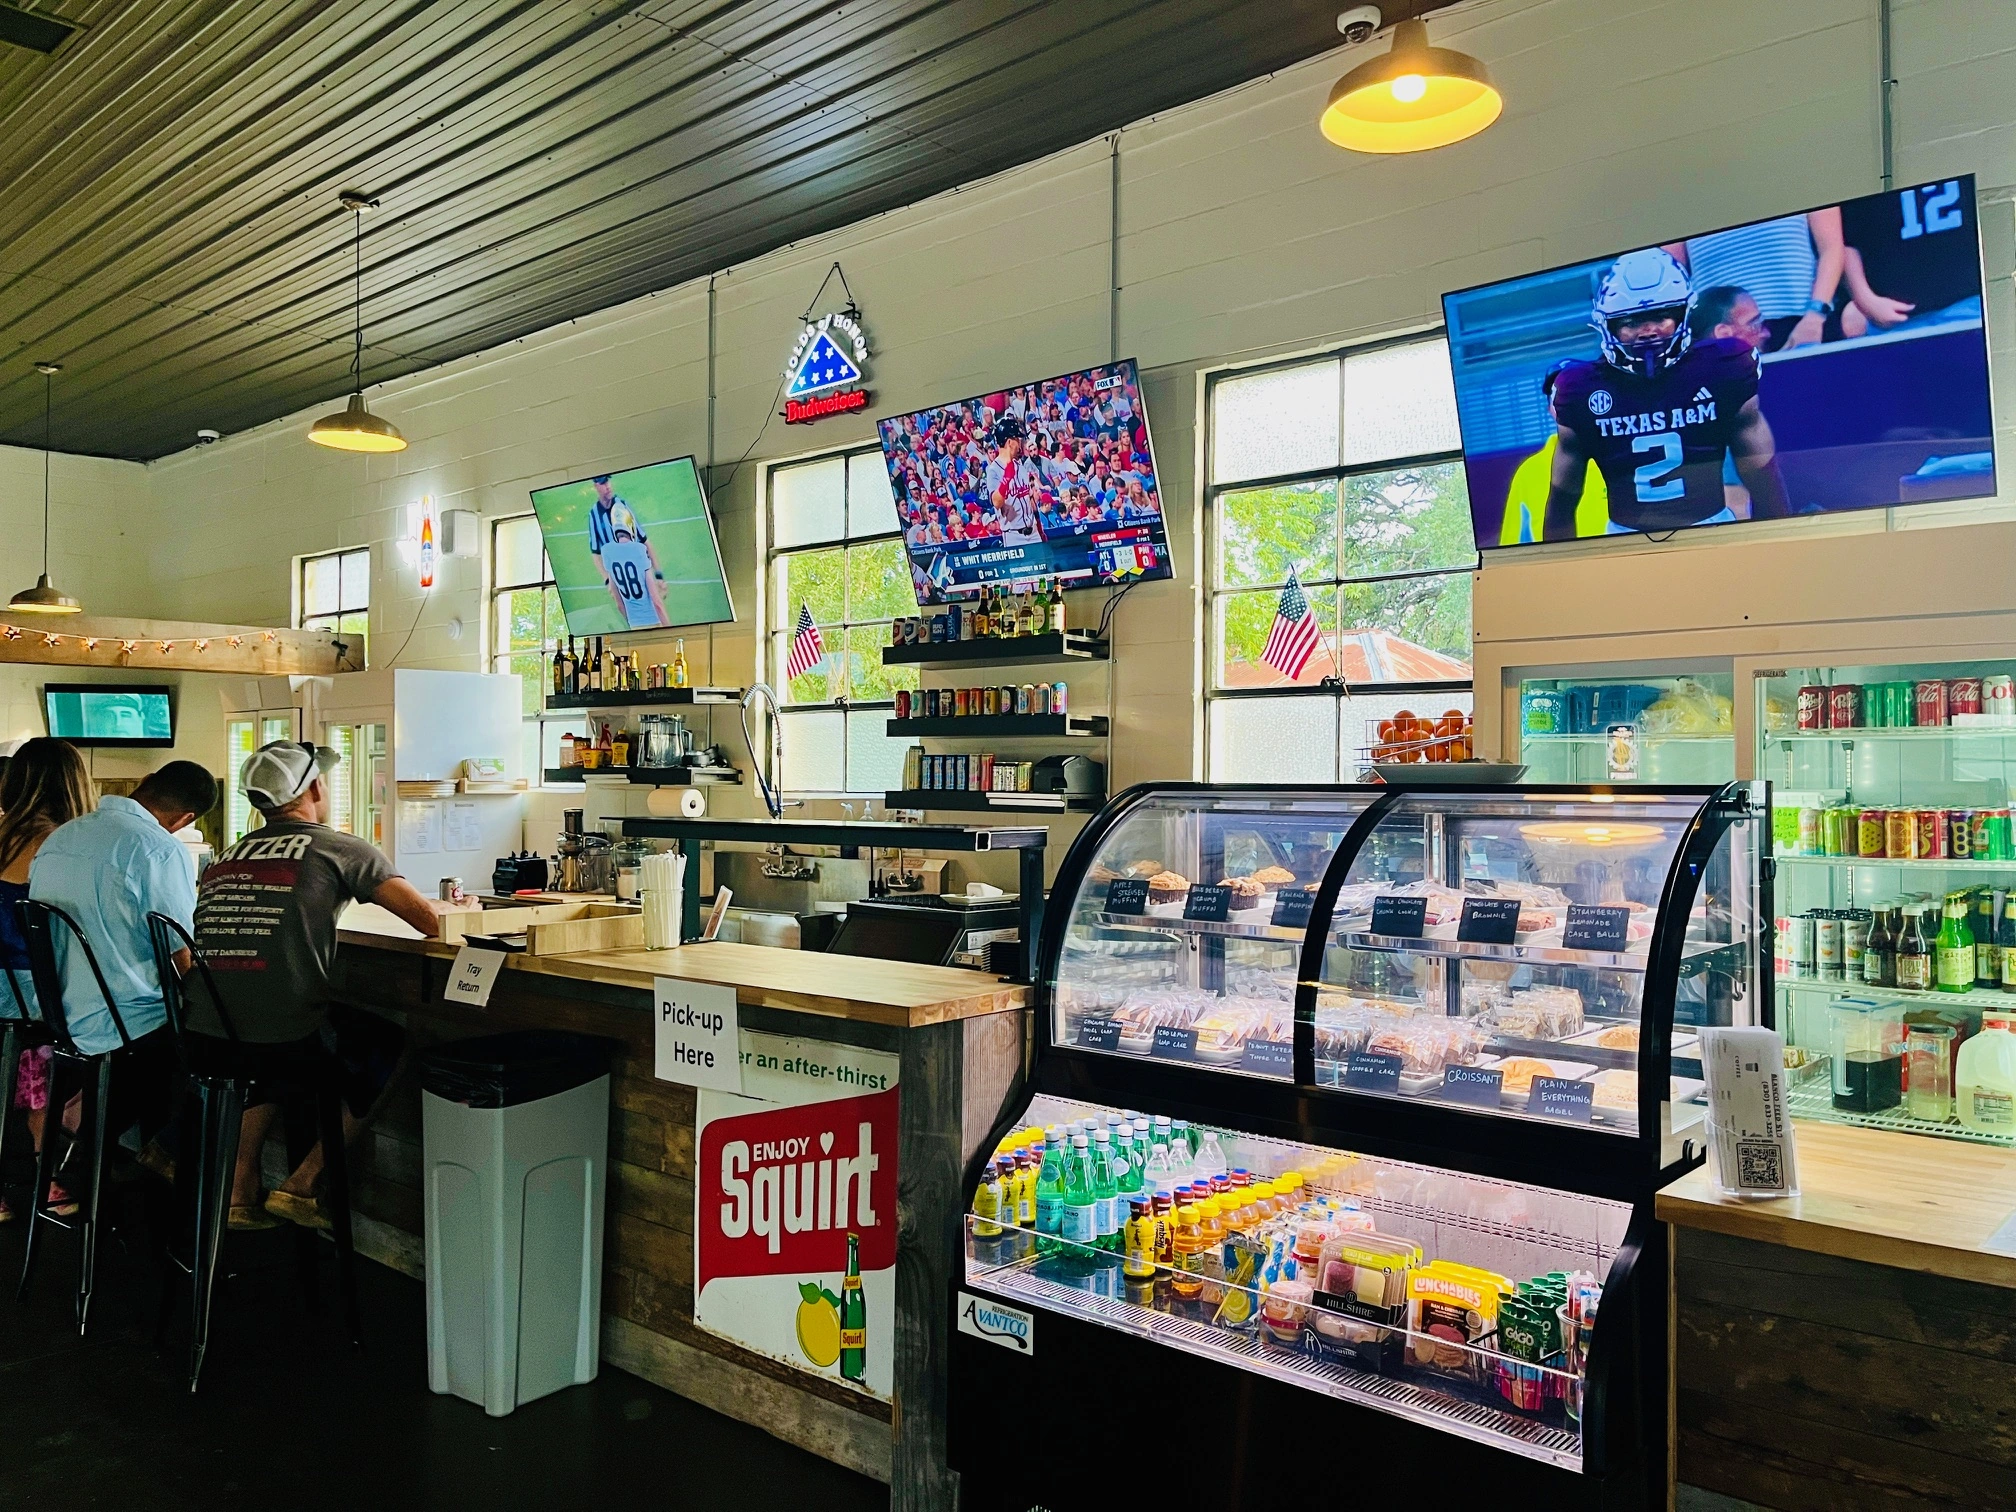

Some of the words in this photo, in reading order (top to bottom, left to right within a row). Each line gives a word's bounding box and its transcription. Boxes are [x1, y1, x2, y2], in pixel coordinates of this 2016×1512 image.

[1901, 181, 1962, 239] 12
[834, 314, 868, 362] HONOR
[1097, 380, 1109, 388] FOX
[787, 391, 865, 421] Budweiser
[1590, 391, 1611, 414] SEC
[1596, 412, 1666, 436] TEXAS
[1671, 402, 1717, 428] A&M
[1632, 431, 1685, 502] 2
[962, 555, 980, 566] WHIT
[982, 548, 1025, 563] MERRIFIELD
[1099, 551, 1111, 560] ATL
[1142, 555, 1150, 567] 0
[612, 561, 644, 600] 98
[1113, 881, 1132, 889] APPLE
[1112, 897, 1138, 905] MUFFIN
[1117, 889, 1145, 898] STREUSEL
[1465, 900, 1499, 908] CHOCOLATE
[1472, 911, 1507, 920] BROWNIE
[1571, 907, 1623, 917] STRAWBERRY
[1570, 918, 1611, 927] LEMONADE
[1568, 930, 1591, 939] CAKE
[1596, 930, 1620, 938] BALLS
[467, 963, 482, 976] Tray
[457, 980, 479, 993] Return
[662, 1001, 723, 1036] Pick-up
[674, 1041, 715, 1068] Here
[756, 1053, 778, 1069] an
[783, 1057, 887, 1090] after-thirst
[1448, 1070, 1502, 1084] CROISSANT
[1540, 1079, 1568, 1090] PLAIN
[1771, 1073, 1779, 1102] BLANCO
[1541, 1092, 1590, 1104] EVERYTHING
[753, 1137, 810, 1162] ENJOY
[720, 1122, 880, 1254] Squirt
[844, 1278, 859, 1287] Squirt
[1414, 1277, 1482, 1308] LUNCHABLES
[992, 1306, 1028, 1322] REFRIGERATION
[1326, 1298, 1373, 1318] HILLSHIRE
[963, 1300, 1028, 1340] AVANTCO
[843, 1332, 862, 1345] Squirt
